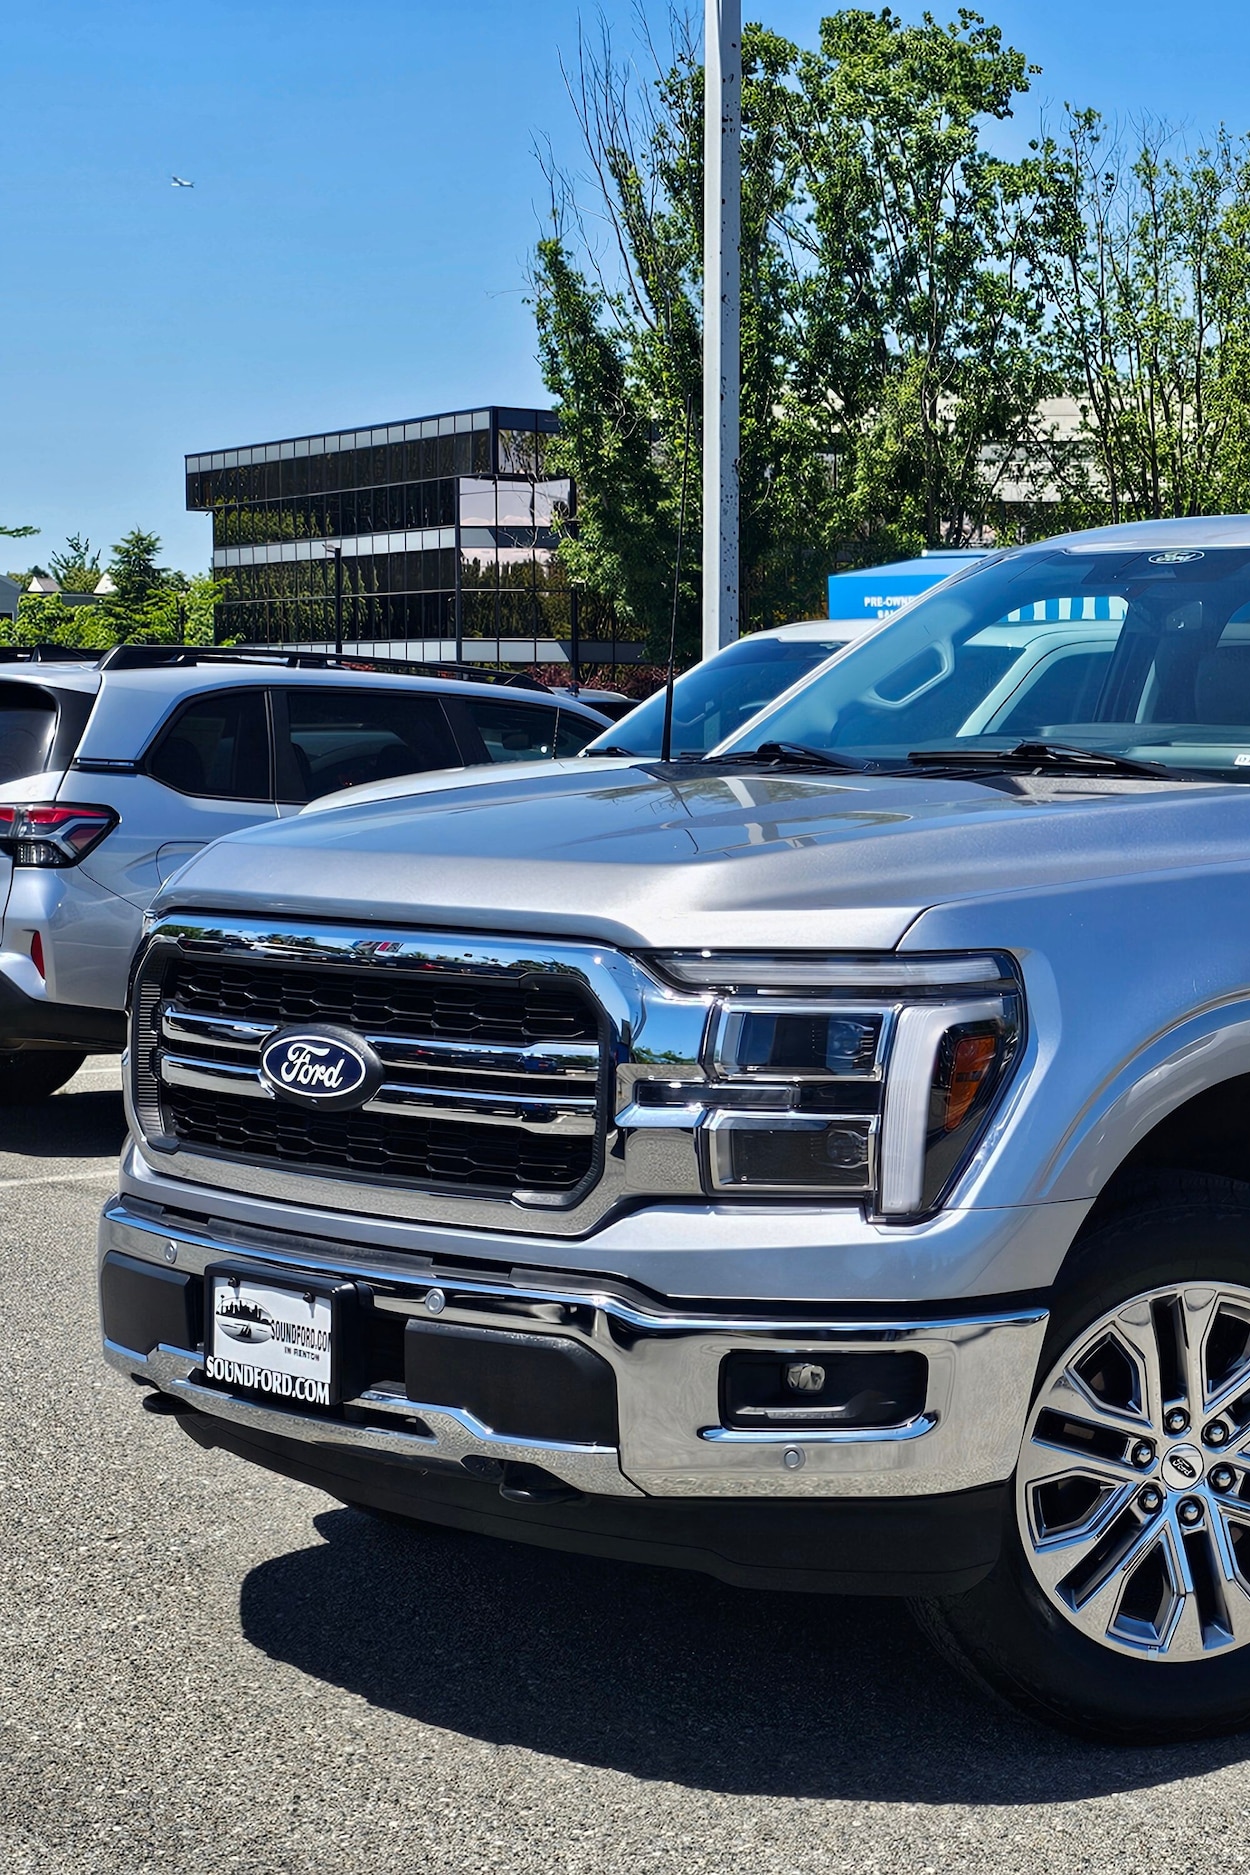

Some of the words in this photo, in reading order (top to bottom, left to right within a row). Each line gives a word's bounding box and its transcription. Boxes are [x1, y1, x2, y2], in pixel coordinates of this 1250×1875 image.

[281, 1043, 345, 1089] Ford
[206, 1355, 330, 1406] SOUNDFORD.COM
[1172, 1457, 1193, 1477] Ford
